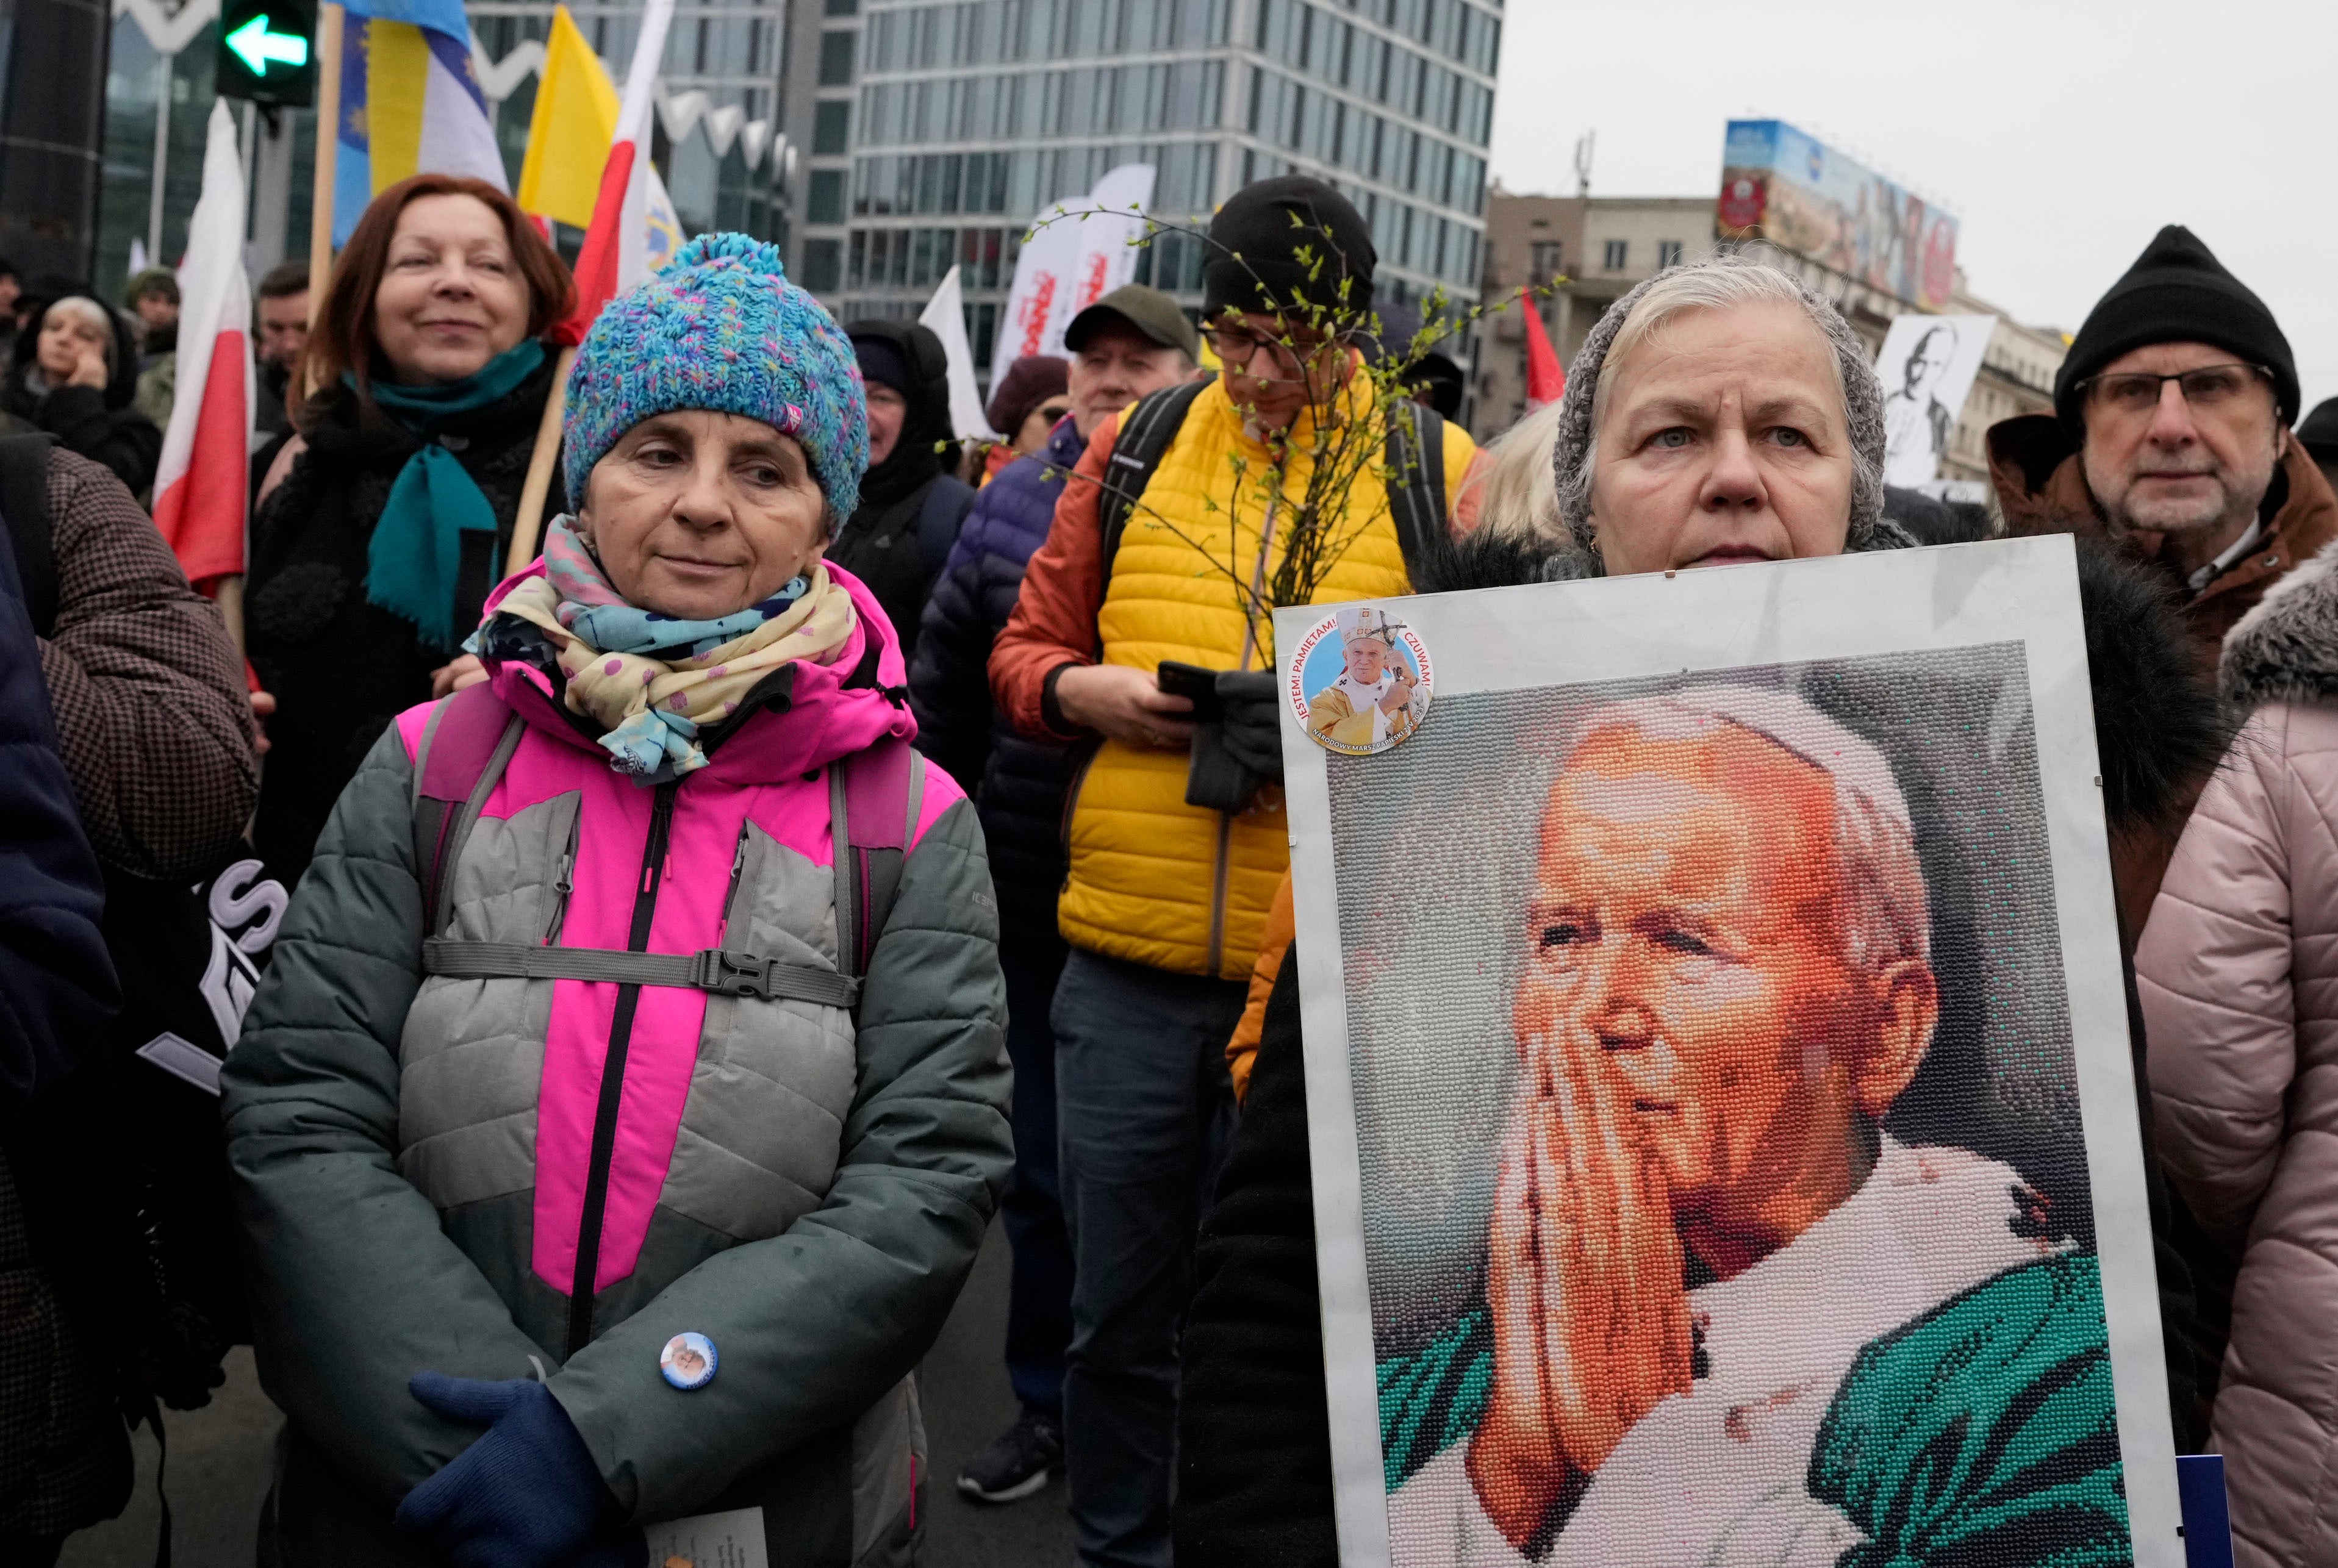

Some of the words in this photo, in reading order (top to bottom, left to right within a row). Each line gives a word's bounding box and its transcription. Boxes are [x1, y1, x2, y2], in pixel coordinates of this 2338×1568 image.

[1293, 618, 1336, 673] PAMIĘTAM!
[1404, 632, 1430, 686] CZUWAM!
[1291, 676, 1310, 720] JESTEM!
[1313, 729, 1350, 751] NARODOWY
[1376, 731, 1405, 750] PAPIESKI
[1412, 707, 1424, 722] 2023
